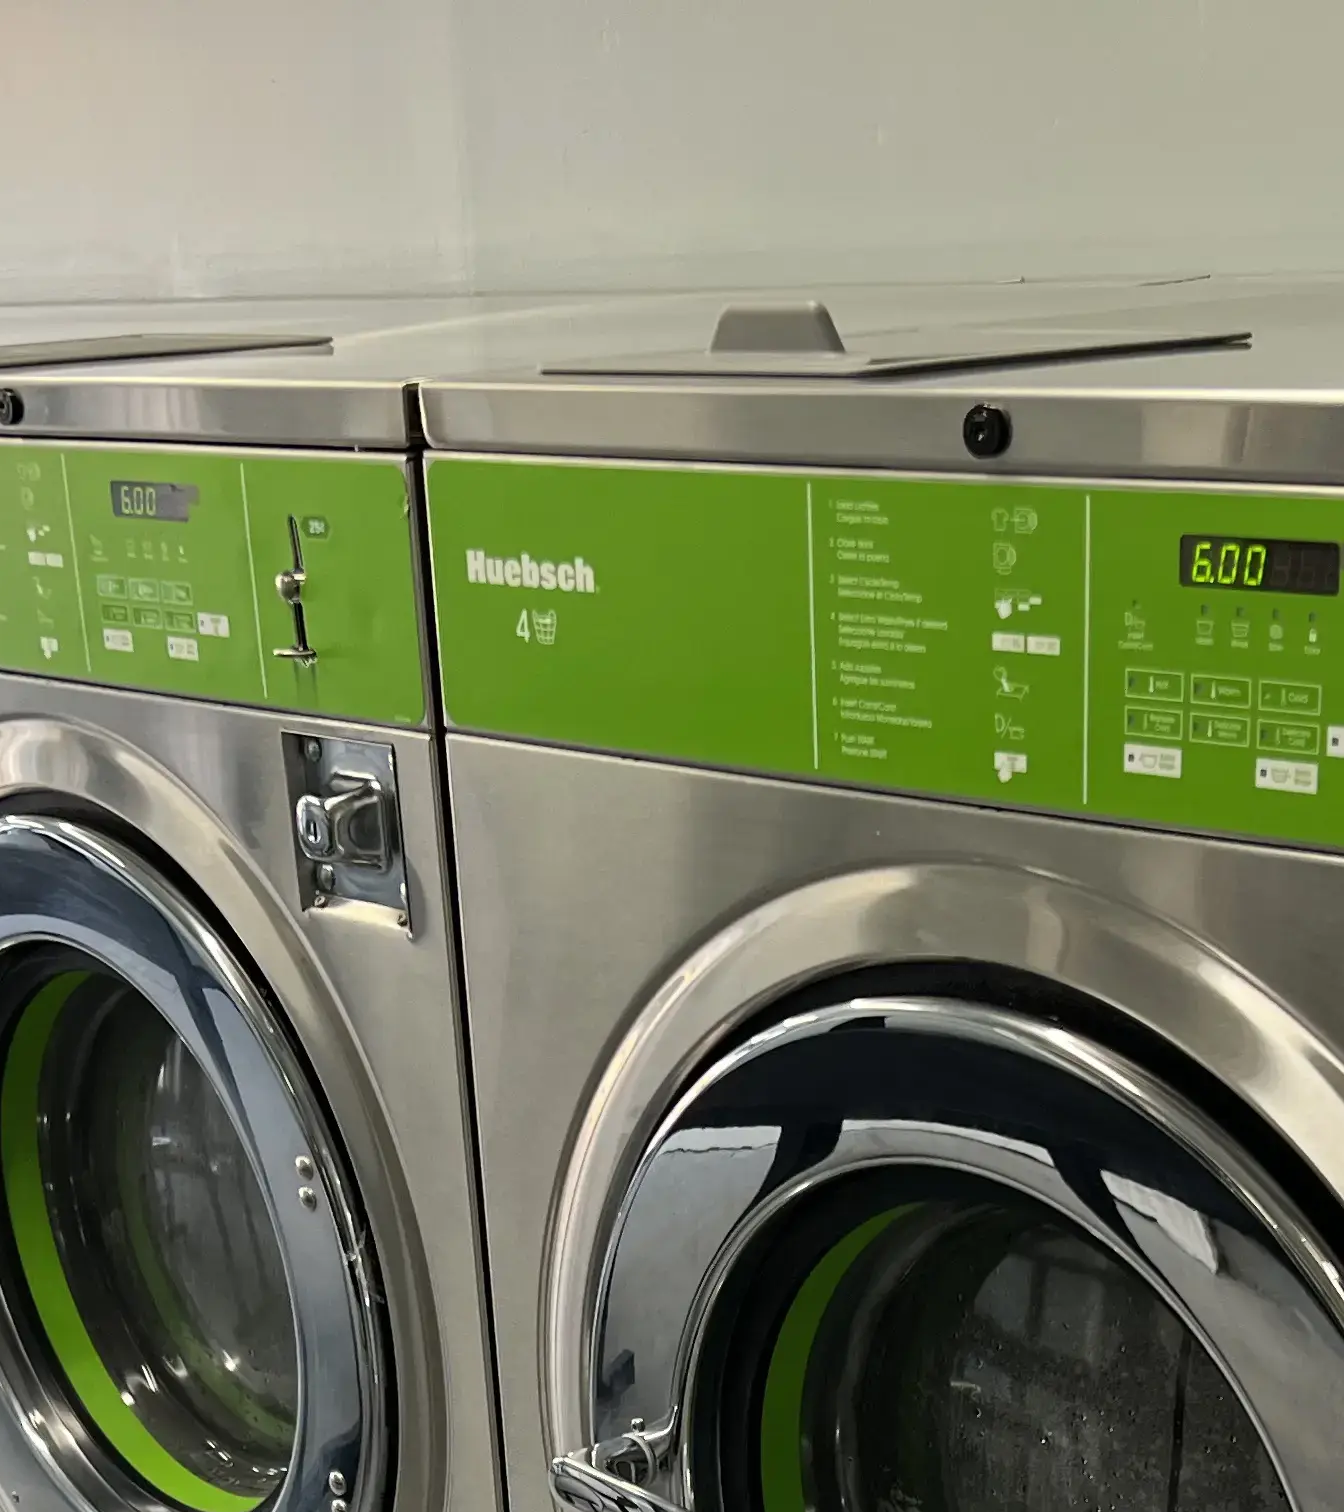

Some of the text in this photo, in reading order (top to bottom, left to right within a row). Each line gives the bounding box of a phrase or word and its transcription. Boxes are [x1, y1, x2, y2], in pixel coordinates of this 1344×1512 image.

[466, 549, 595, 593] Huebsch
[1191, 541, 1266, 586] 6.00
[516, 609, 530, 643] 4
